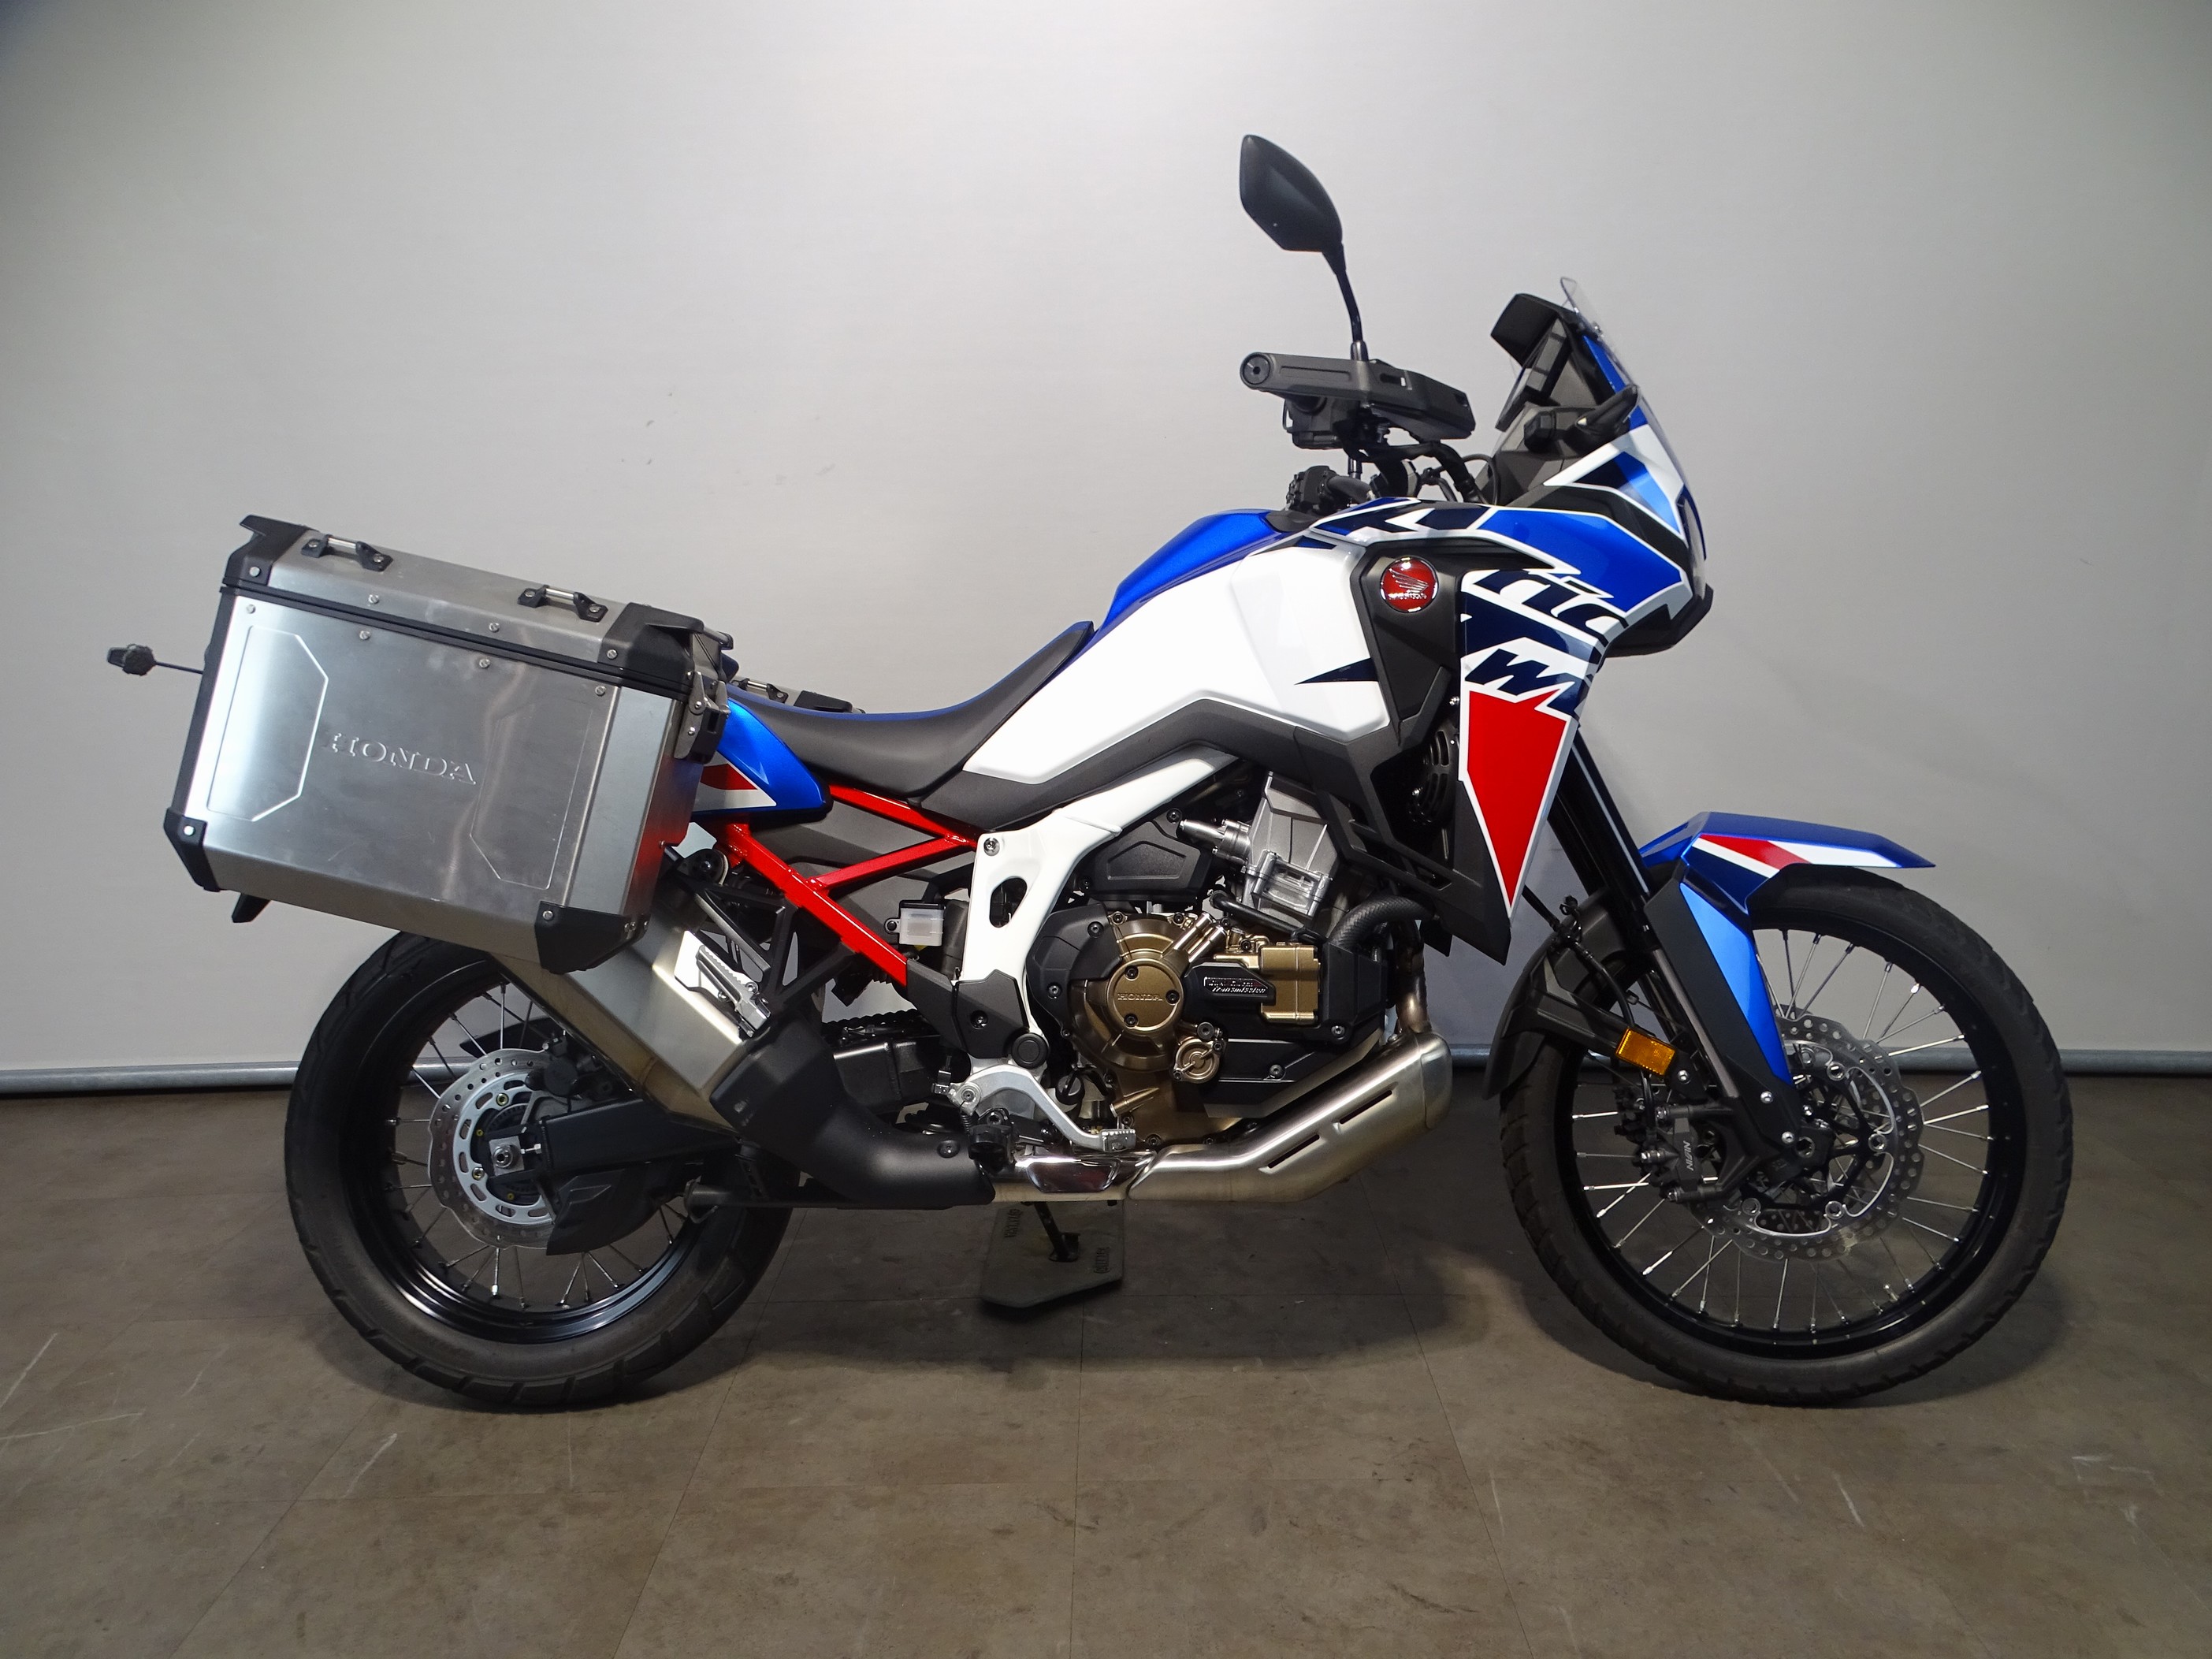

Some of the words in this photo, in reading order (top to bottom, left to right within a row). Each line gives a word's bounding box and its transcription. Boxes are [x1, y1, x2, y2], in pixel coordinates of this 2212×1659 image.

[324, 732, 477, 785] HONDA
[1117, 992, 1164, 1002] HONDA
[1682, 1140, 1694, 1172] NISSIN
